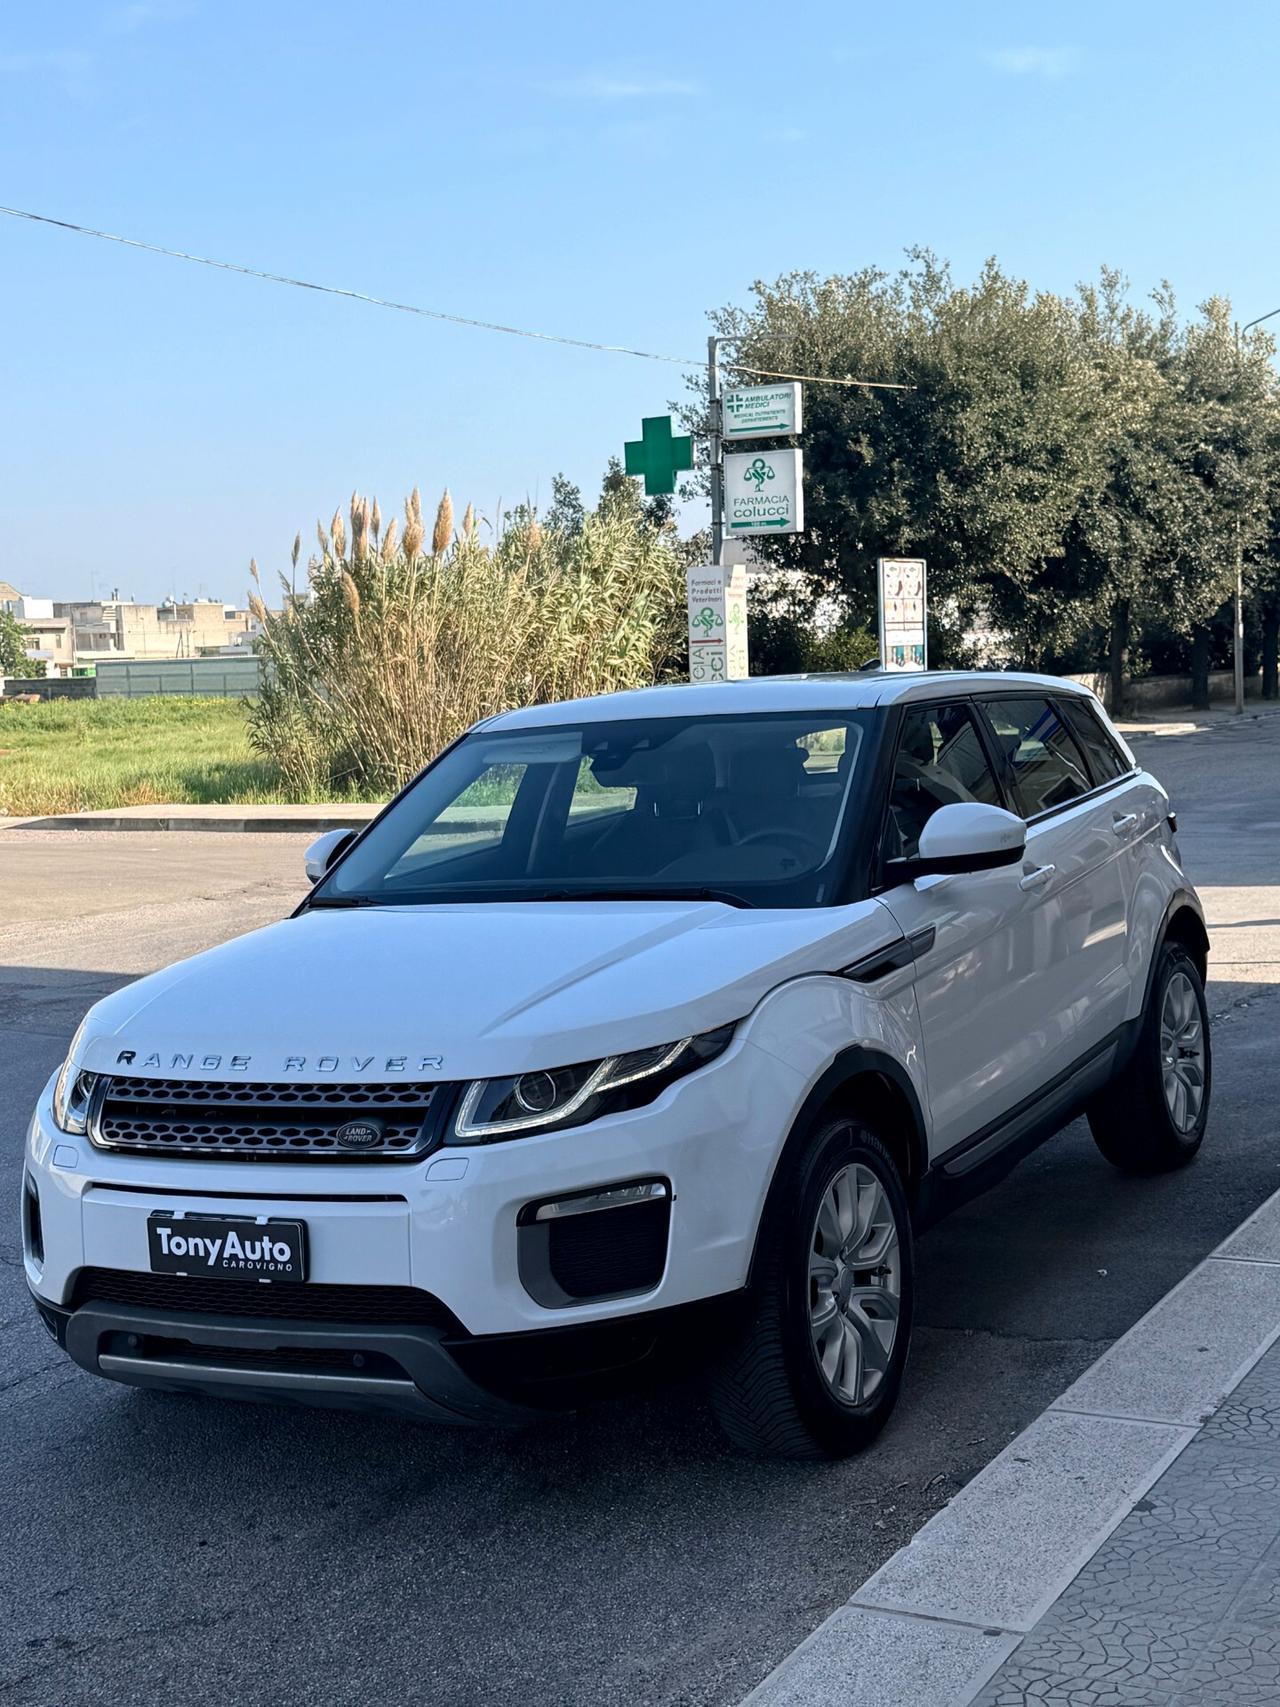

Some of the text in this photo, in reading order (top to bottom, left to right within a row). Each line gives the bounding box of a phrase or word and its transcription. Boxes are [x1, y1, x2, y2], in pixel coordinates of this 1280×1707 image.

[744, 392, 792, 402] AMBULATORI
[744, 401, 770, 409] MEDICI
[733, 495, 790, 506] FARMACIA
[733, 503, 789, 518] colucci
[691, 586, 722, 595] Prodotti
[116, 1050, 444, 1073] RANGE ROVER
[345, 1127, 367, 1135] LAND
[347, 1134, 373, 1142] ROVER
[156, 1227, 291, 1266] TonyAuto
[222, 1259, 293, 1272] CAROVIGNO
